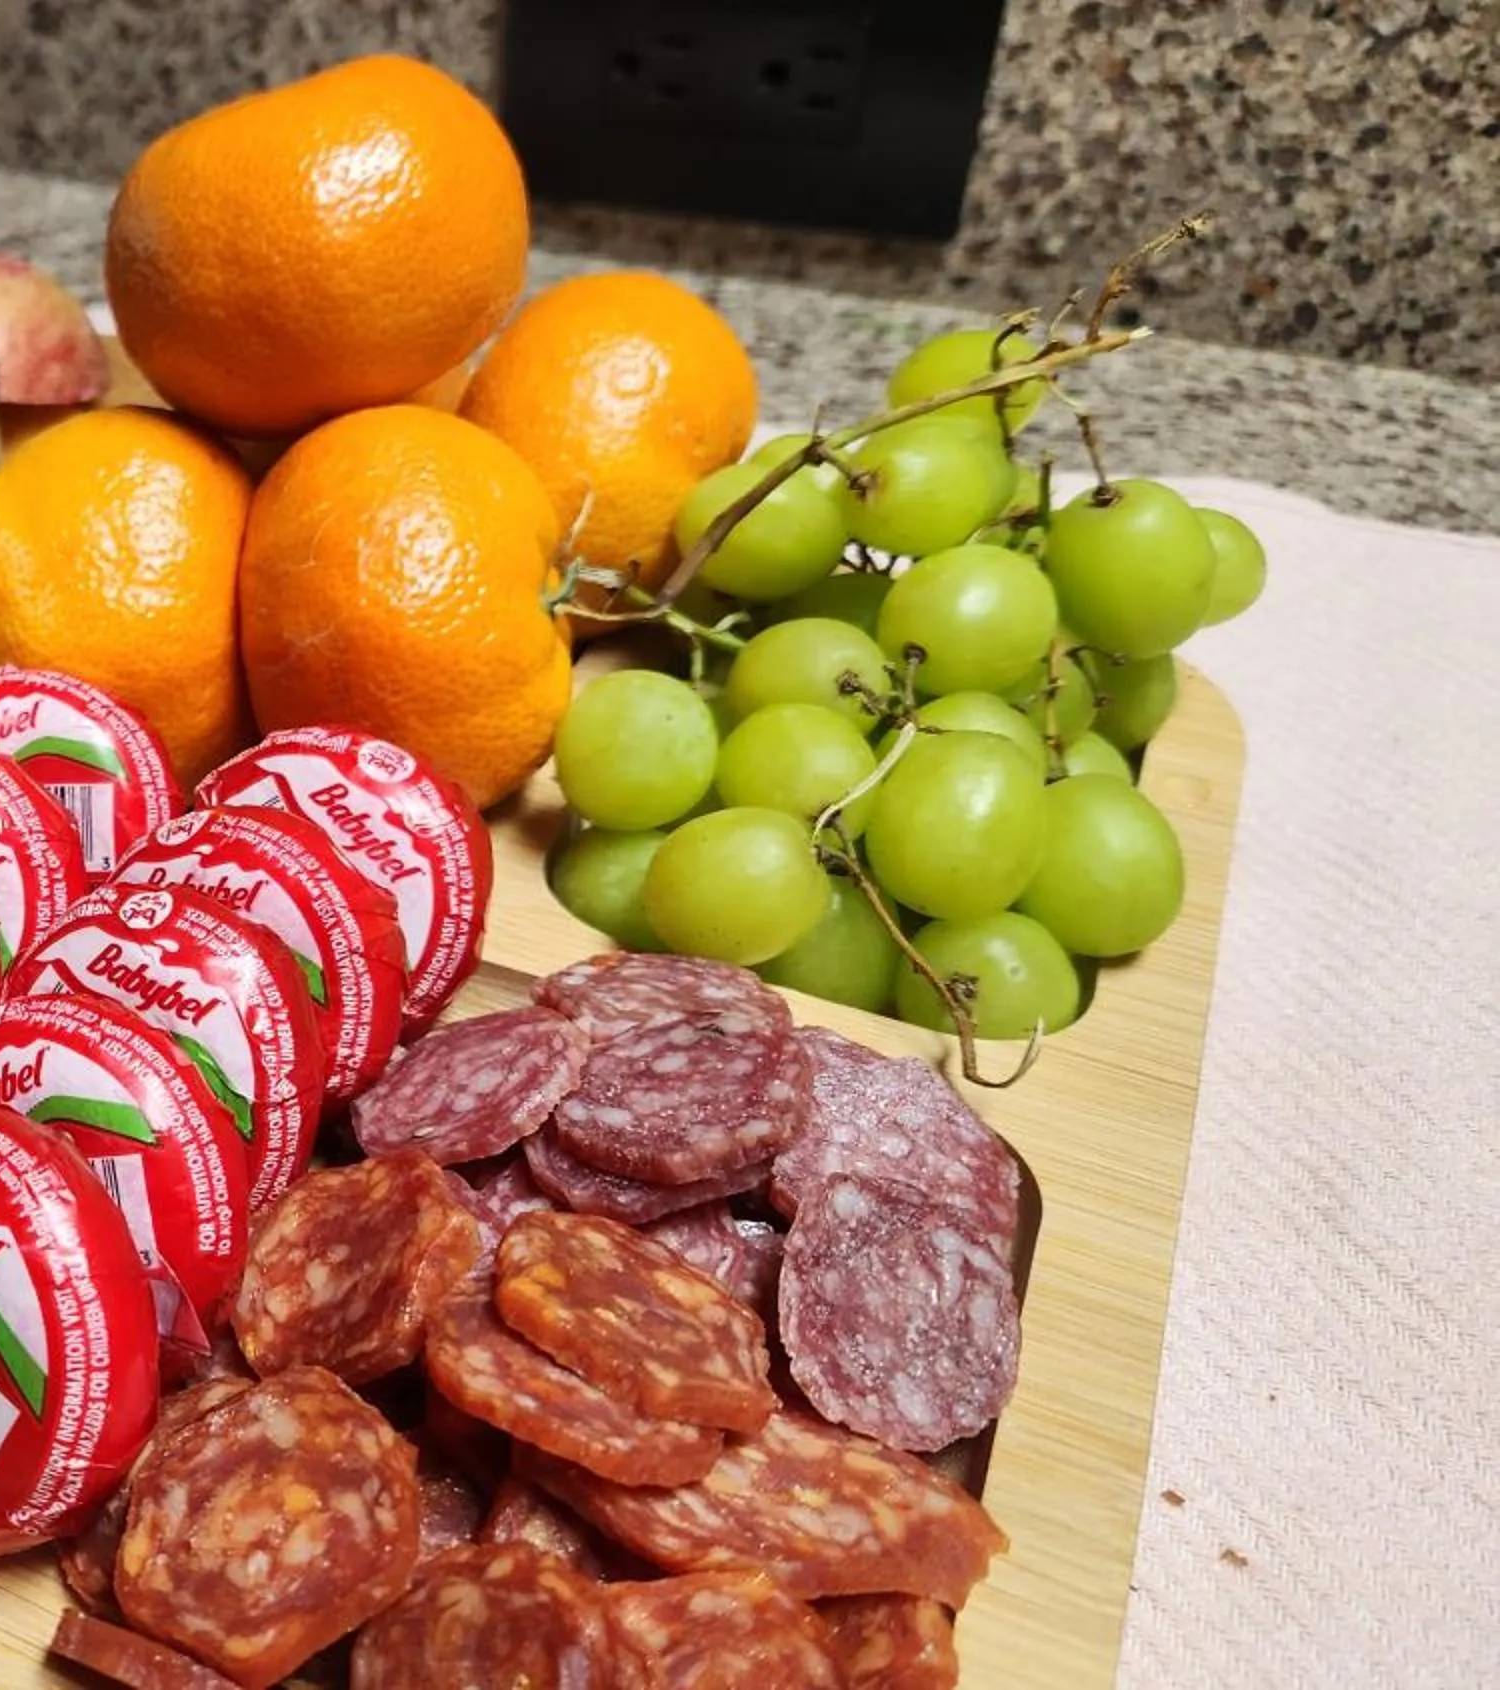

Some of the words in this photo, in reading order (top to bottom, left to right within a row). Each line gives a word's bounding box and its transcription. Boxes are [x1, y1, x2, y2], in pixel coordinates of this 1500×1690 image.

[308, 783, 422, 882] Babybel
[86, 943, 219, 1027] Babybel
[129, 1059, 192, 1143] INFOON
[182, 1143, 213, 1218] NUTRITION
[198, 1222, 215, 1249] FOR
[53, 1288, 80, 1327] VISIT
[54, 1329, 84, 1441] INFORMATION
[88, 1371, 110, 1399] FOR
